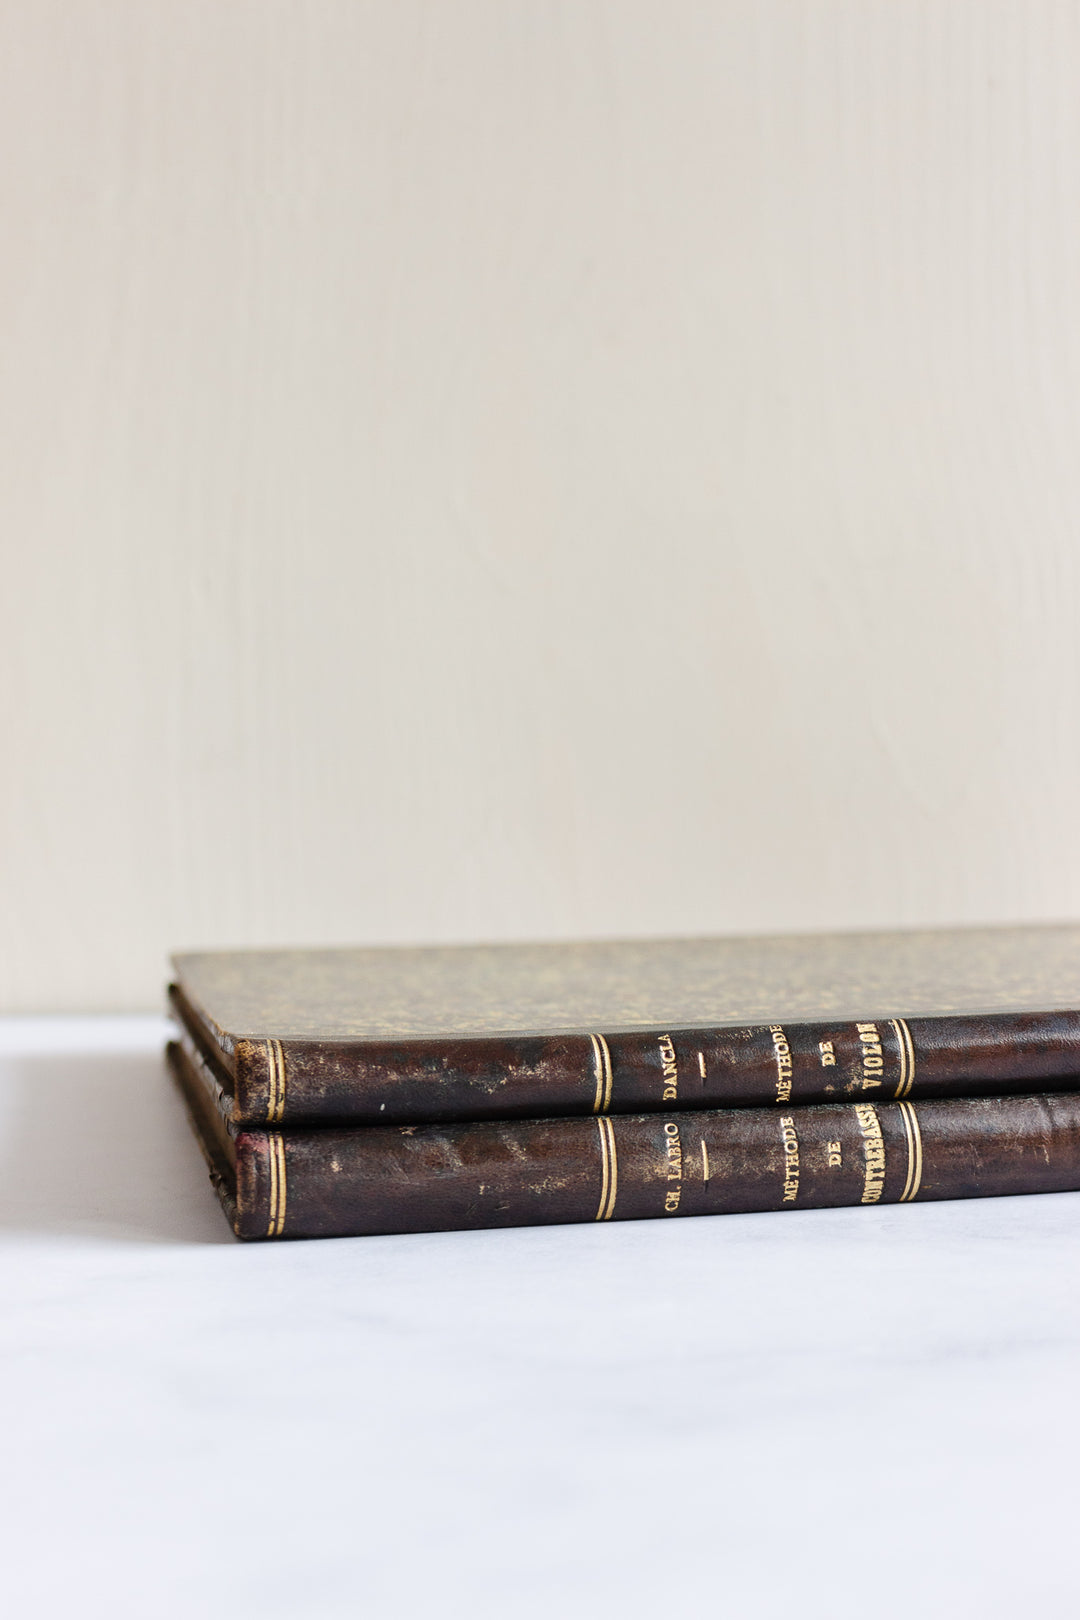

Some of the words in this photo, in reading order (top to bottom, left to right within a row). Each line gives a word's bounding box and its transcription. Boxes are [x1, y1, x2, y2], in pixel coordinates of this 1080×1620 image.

[657, 1034, 678, 1101] DANCLA
[769, 1024, 793, 1102] MÉTHODE
[818, 1041, 837, 1067] DE
[856, 1023, 884, 1090] VIOLON
[664, 1122, 682, 1181] LABRO
[828, 1141, 842, 1168] DE
[854, 1104, 886, 1203] CONTREBASSE
[664, 1185, 682, 1212] CH.
